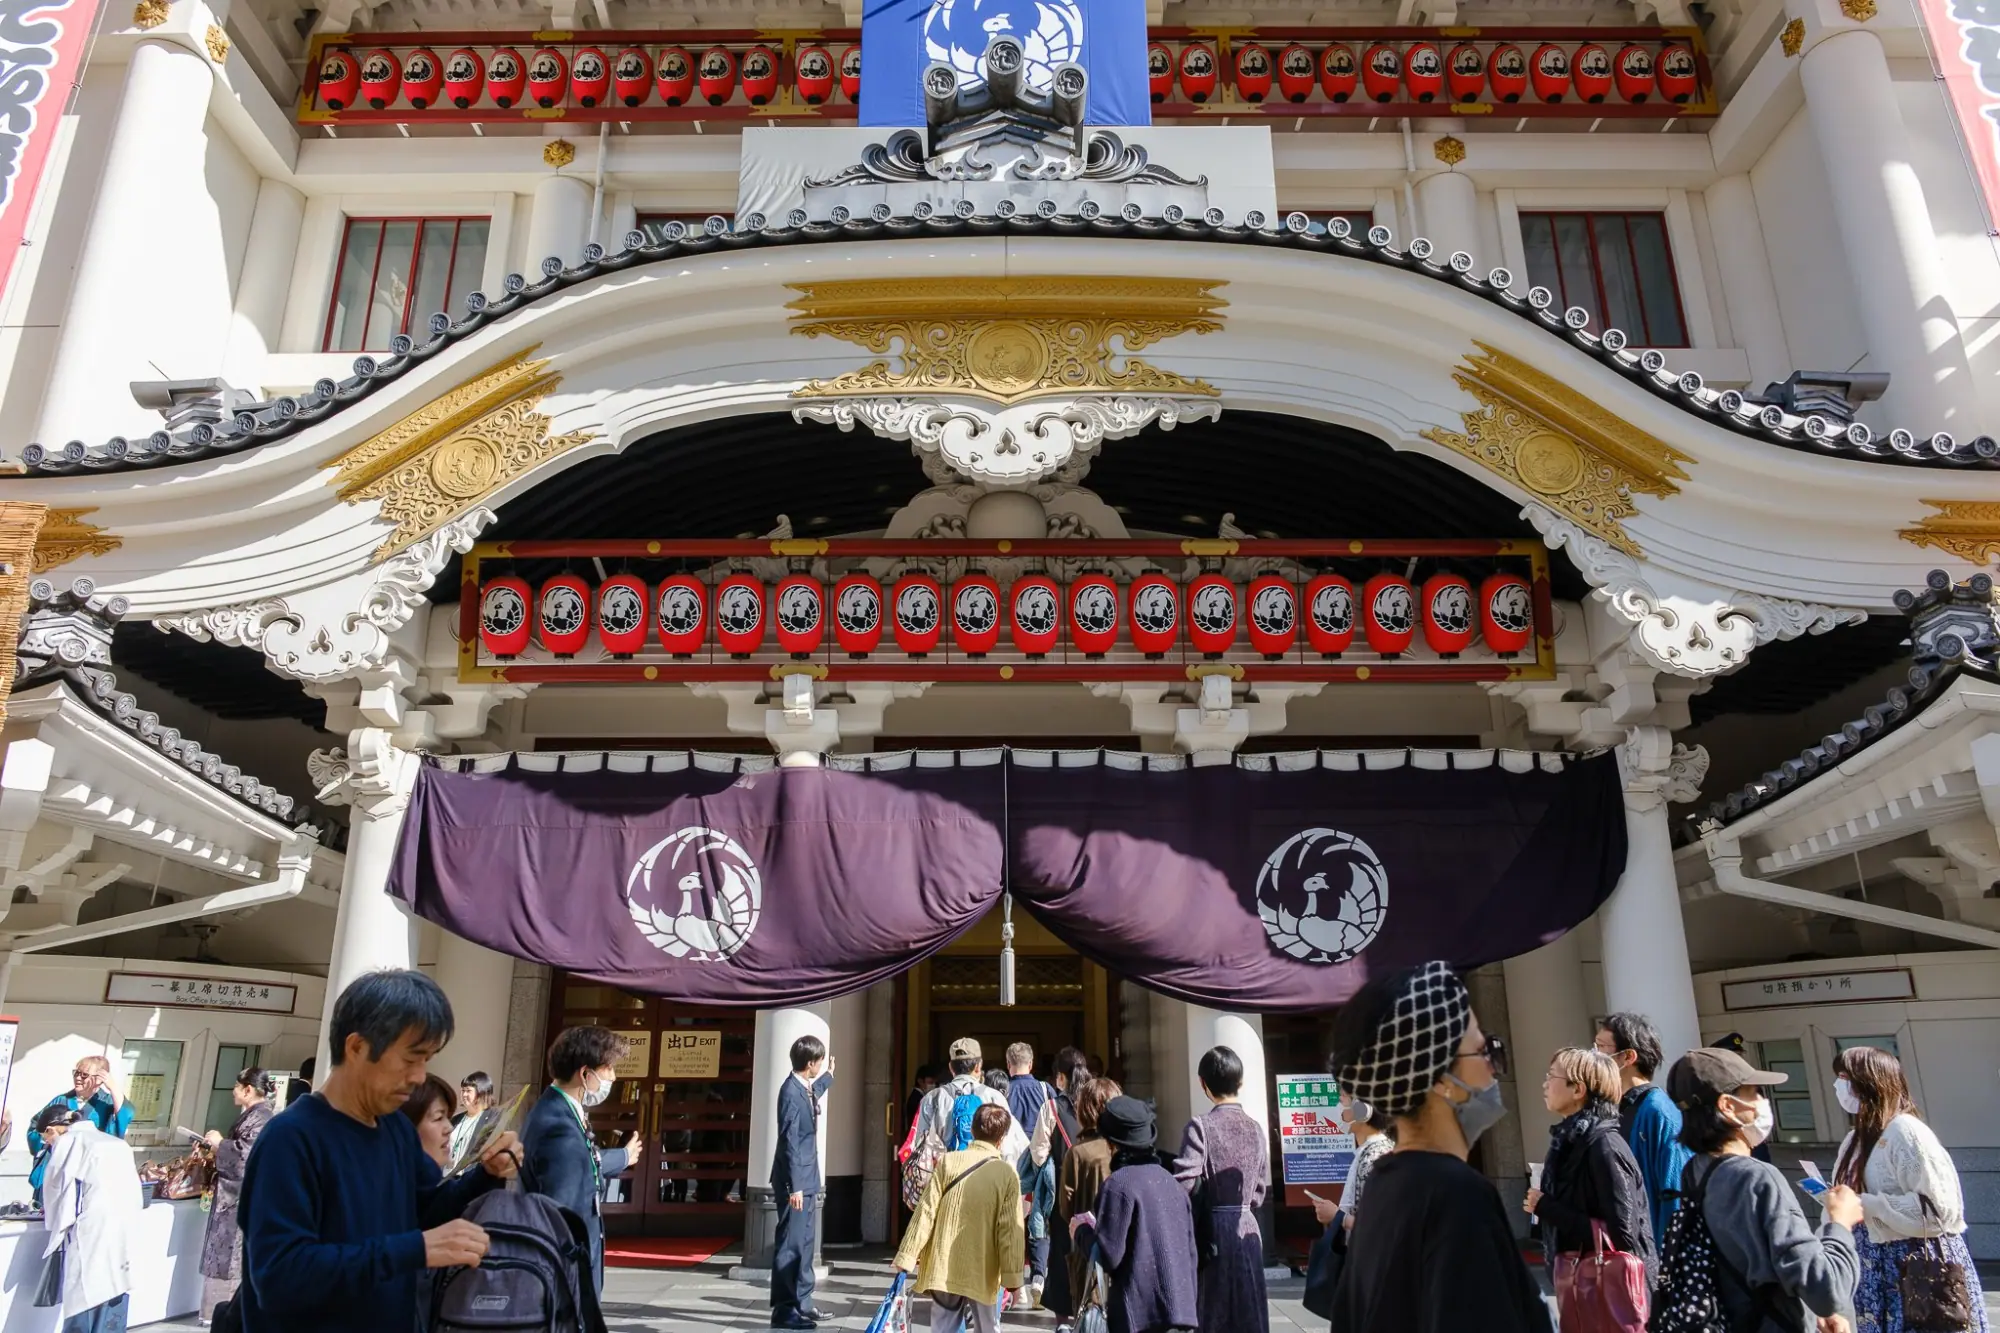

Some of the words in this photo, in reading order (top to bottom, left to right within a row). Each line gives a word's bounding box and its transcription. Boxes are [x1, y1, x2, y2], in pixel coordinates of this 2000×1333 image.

[151, 980, 269, 999] 一幕見席切符売場
[1762, 976, 1852, 994] 切符預かり所
[175, 995, 188, 1003] Box
[189, 996, 208, 1004] Office
[210, 997, 218, 1005] for
[219, 998, 236, 1007] Single
[237, 999, 247, 1007] Act
[629, 1037, 647, 1046] EXIT
[667, 1033, 697, 1049] 出口
[699, 1037, 717, 1046] EXIT
